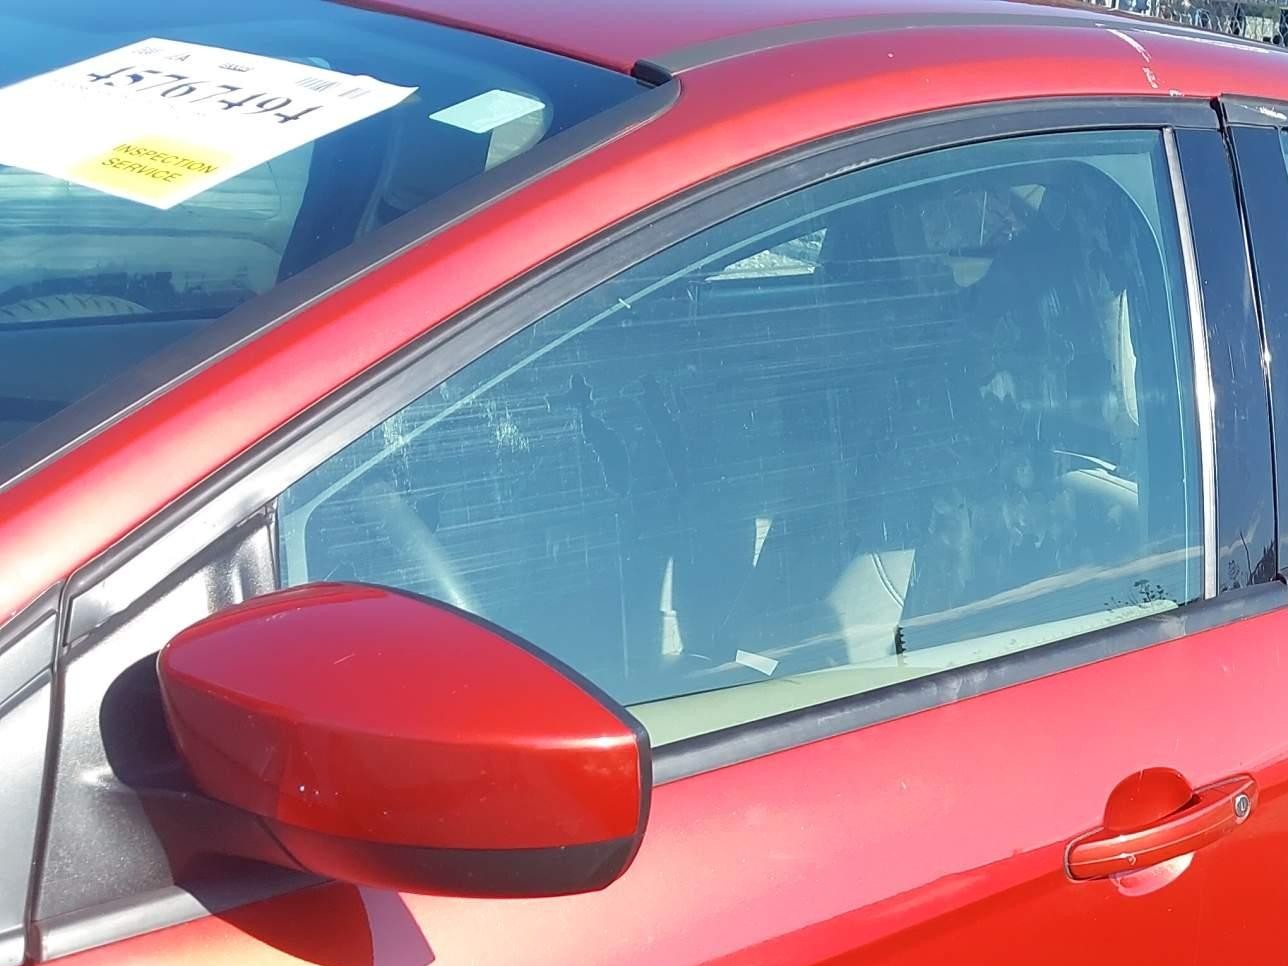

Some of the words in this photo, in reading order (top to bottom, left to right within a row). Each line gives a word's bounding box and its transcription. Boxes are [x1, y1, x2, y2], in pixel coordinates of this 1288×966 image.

[87, 66, 324, 124] 45767494
[101, 157, 183, 183] SERVICE
[112, 143, 219, 174] INSPECTION
